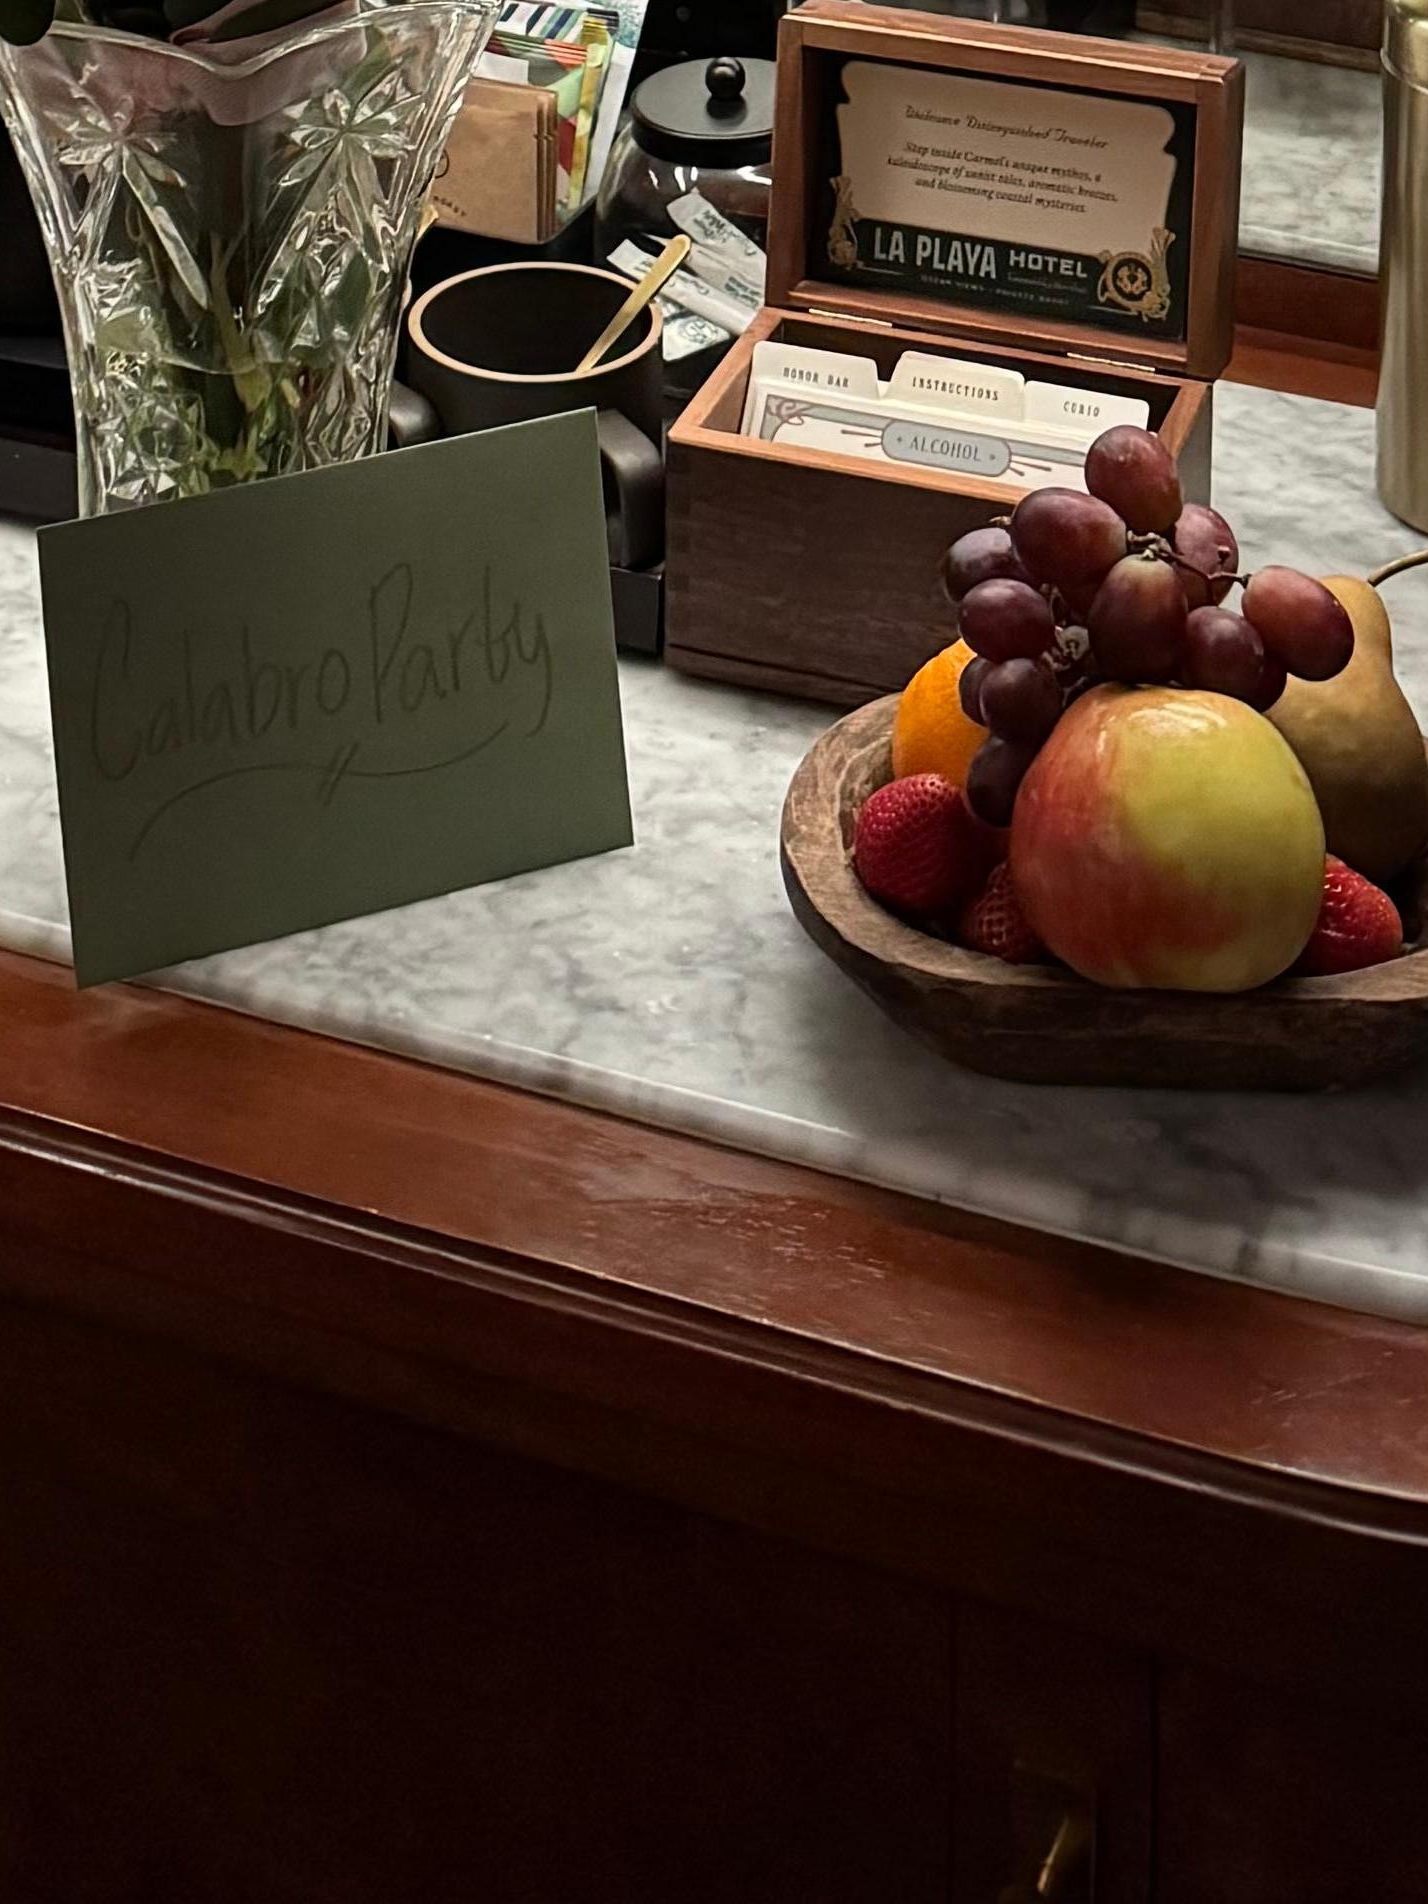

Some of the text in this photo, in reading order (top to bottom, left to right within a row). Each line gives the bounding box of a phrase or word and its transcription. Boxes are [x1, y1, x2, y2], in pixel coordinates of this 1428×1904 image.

[874, 226, 1088, 280] LA PLAYA HOTEL
[782, 366, 849, 389] HONOR BAR
[912, 376, 1000, 401] INSTRUCTIONS
[1063, 400, 1100, 418] CURIO
[908, 435, 982, 463] ALCOHOL
[368, 561, 554, 739] Party
